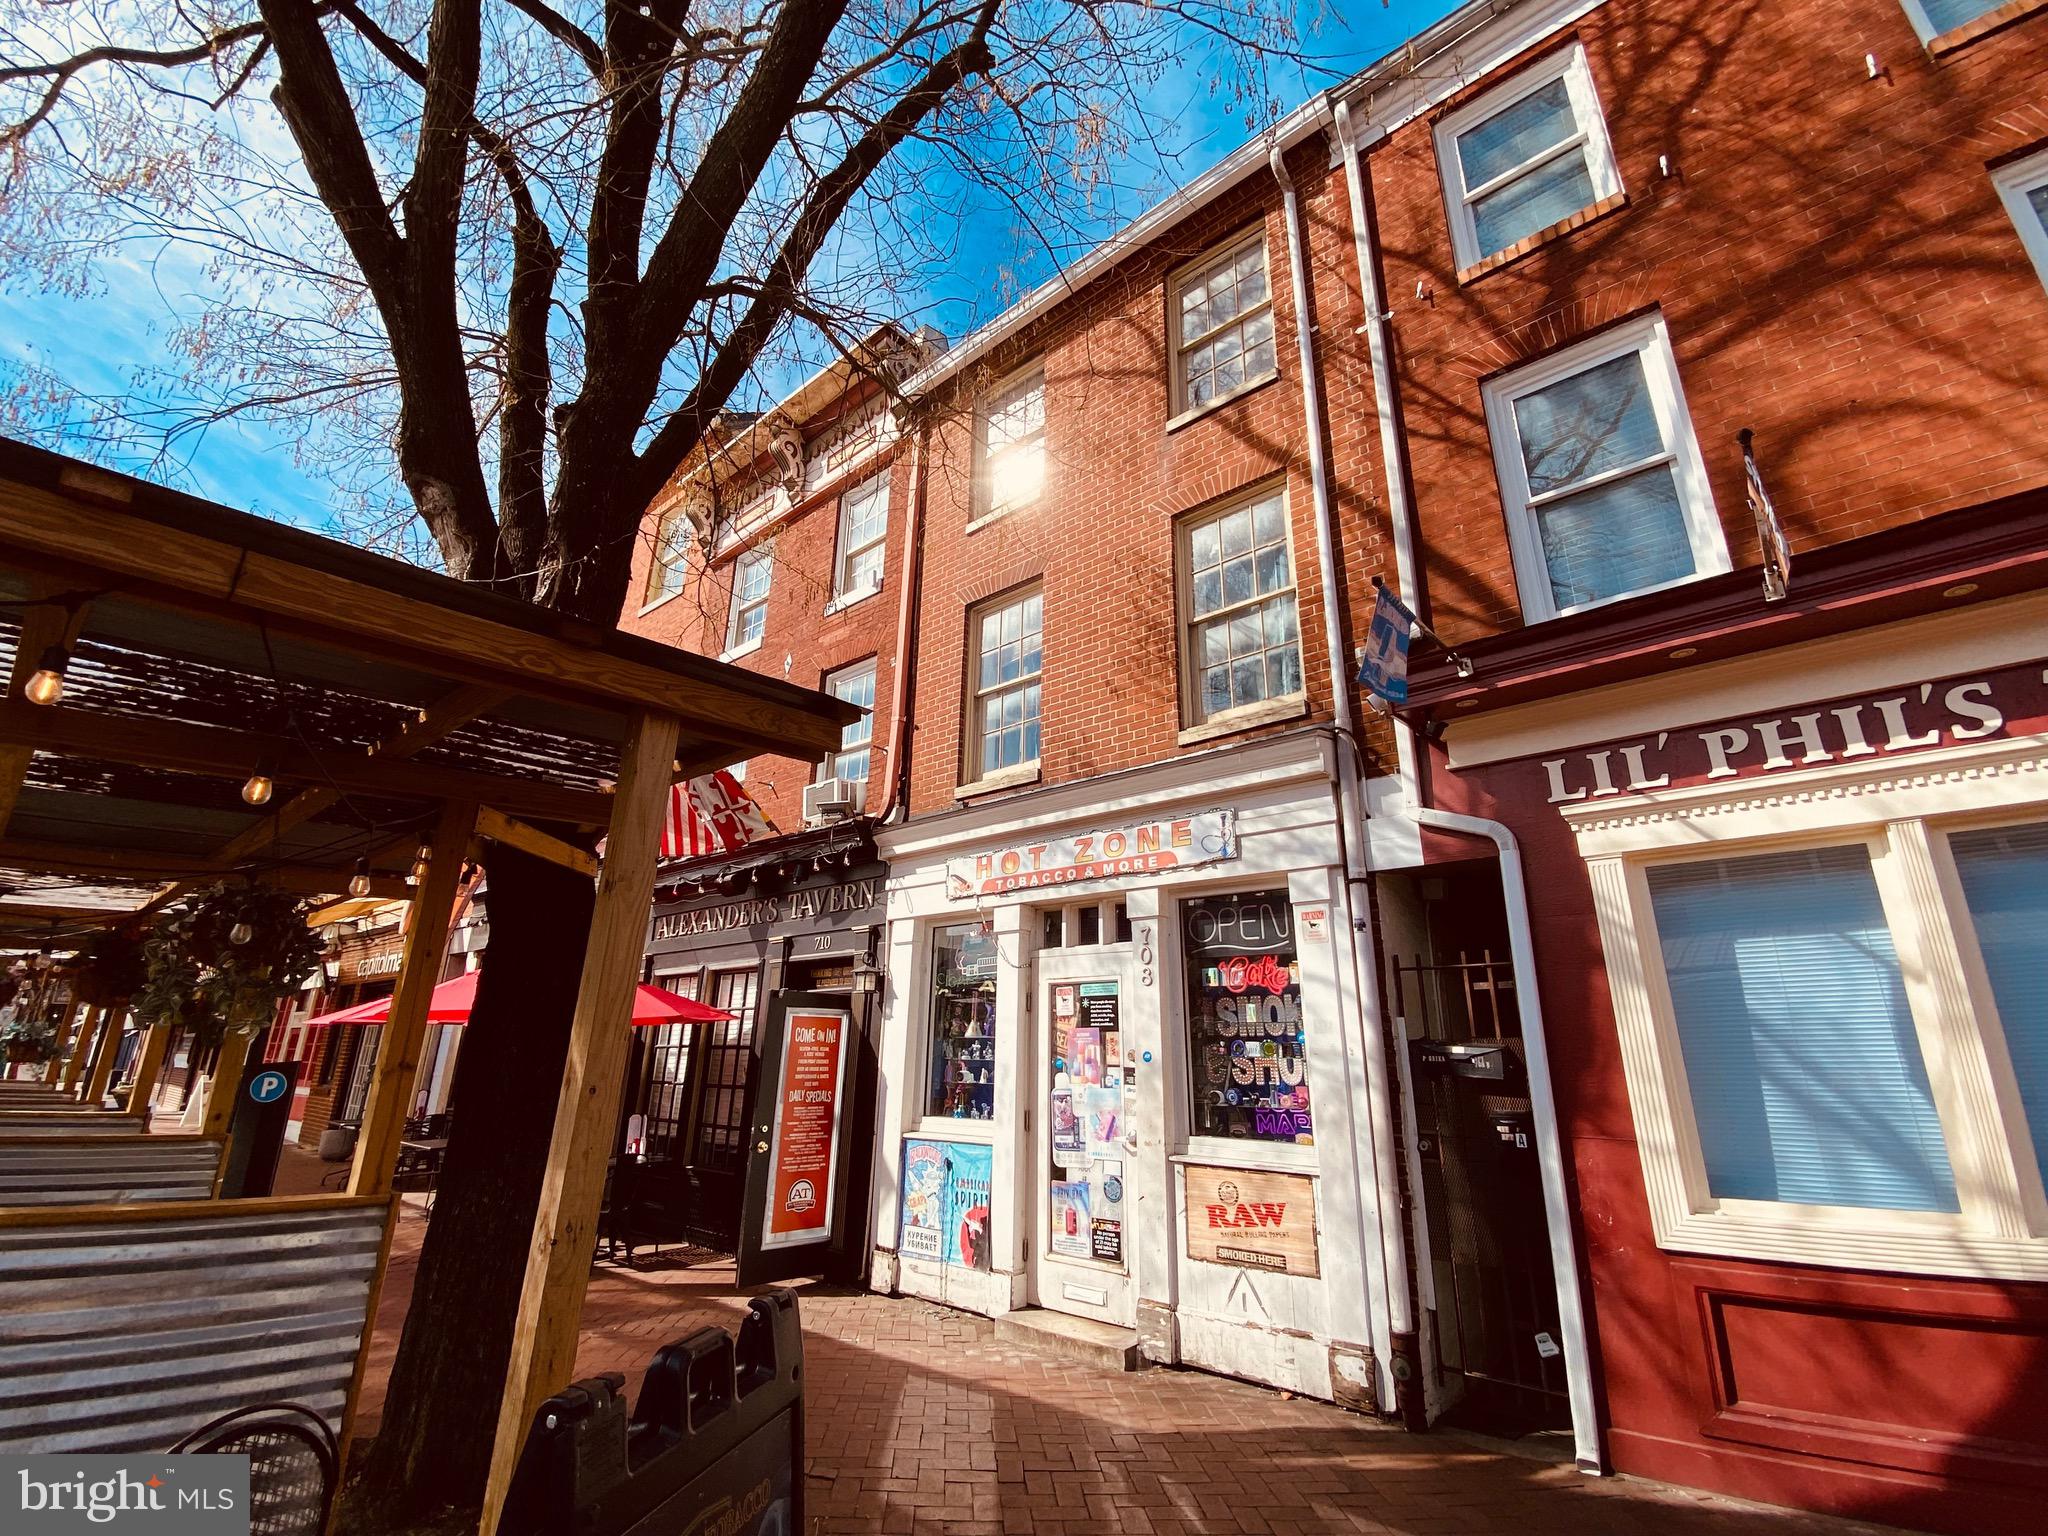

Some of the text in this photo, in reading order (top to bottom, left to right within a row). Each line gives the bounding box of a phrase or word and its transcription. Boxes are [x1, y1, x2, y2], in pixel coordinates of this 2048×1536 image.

[1541, 681, 2004, 803] LIL' PHIL'S
[975, 819, 1192, 881] HOT ZONE
[995, 855, 1158, 891] TOBACCO & MORE
[656, 879, 878, 940] ALEXANDER'S TAVERN
[1188, 902, 1289, 943] OPEN
[814, 935, 832, 950] 710
[1141, 926, 1153, 987] 708
[795, 1027, 816, 1043] COME
[825, 1027, 837, 1043] IN!
[260, 1077, 279, 1097] P
[789, 1089, 832, 1103] DAILY SPECIALS
[792, 1188, 811, 1200] AT
[1205, 1202, 1287, 1228] RAW
[906, 1237, 938, 1252] УБИВАЕТ
[907, 1230, 938, 1243] КУРЕНИЕ
[1218, 1247, 1283, 1267] SMOKED HERE
